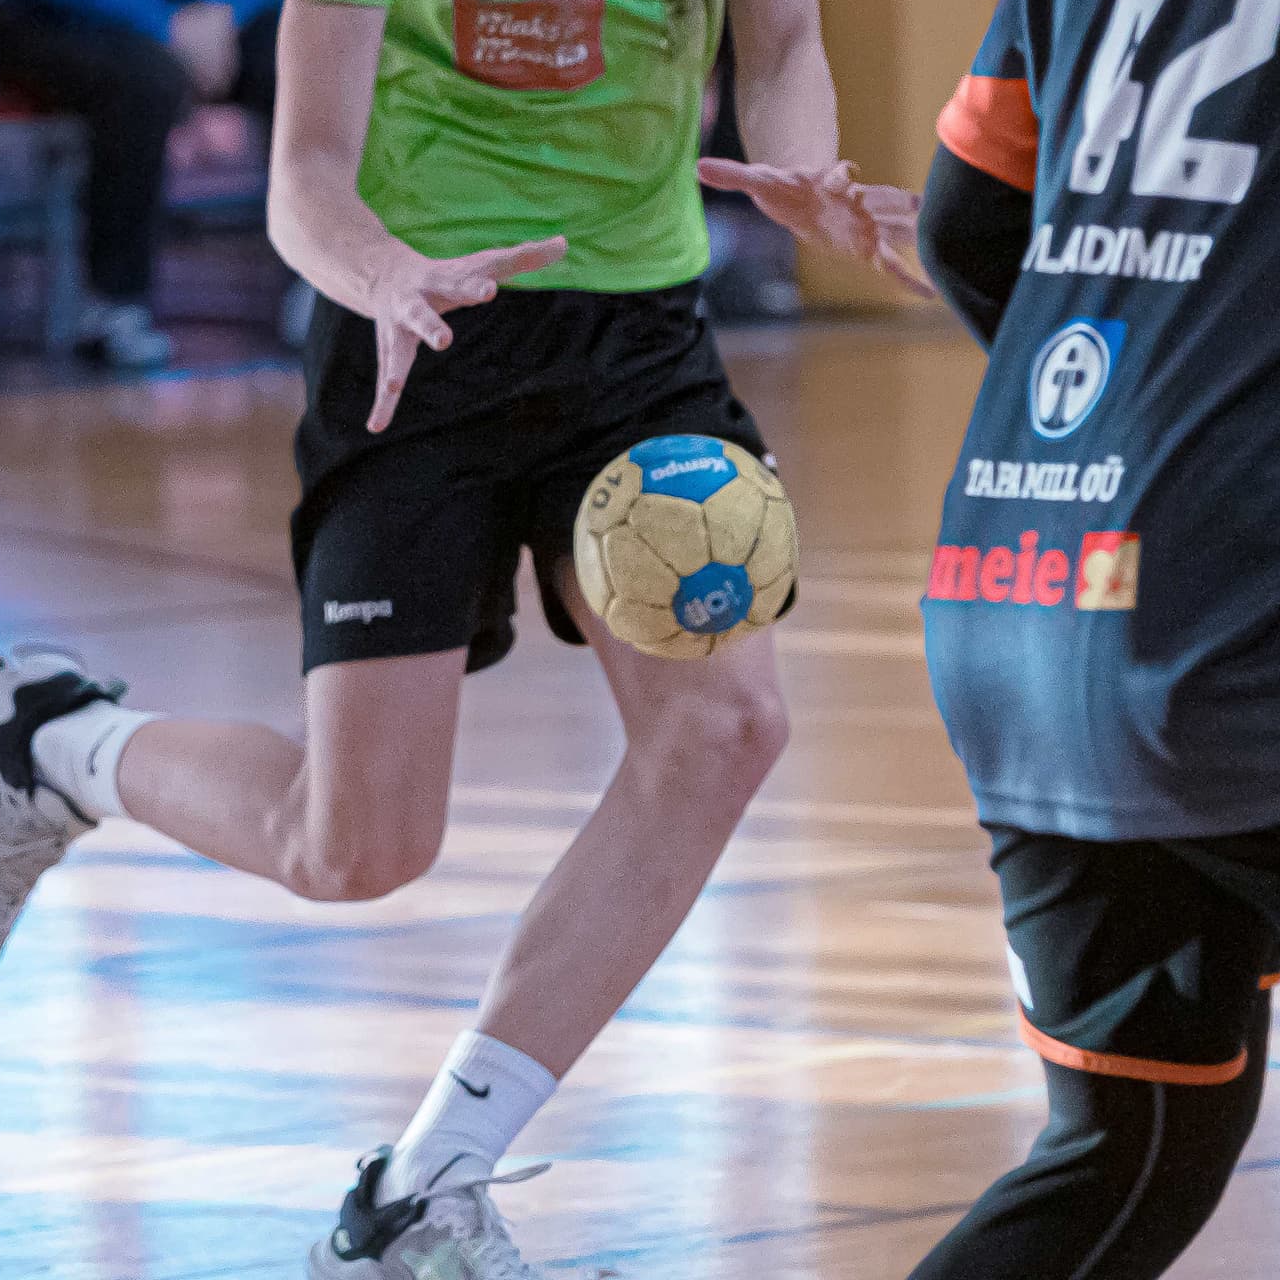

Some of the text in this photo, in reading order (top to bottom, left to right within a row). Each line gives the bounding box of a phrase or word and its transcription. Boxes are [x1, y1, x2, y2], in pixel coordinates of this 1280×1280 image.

[964, 454, 1125, 503] TAPA MILL OÜ
[927, 529, 1070, 606] meie
